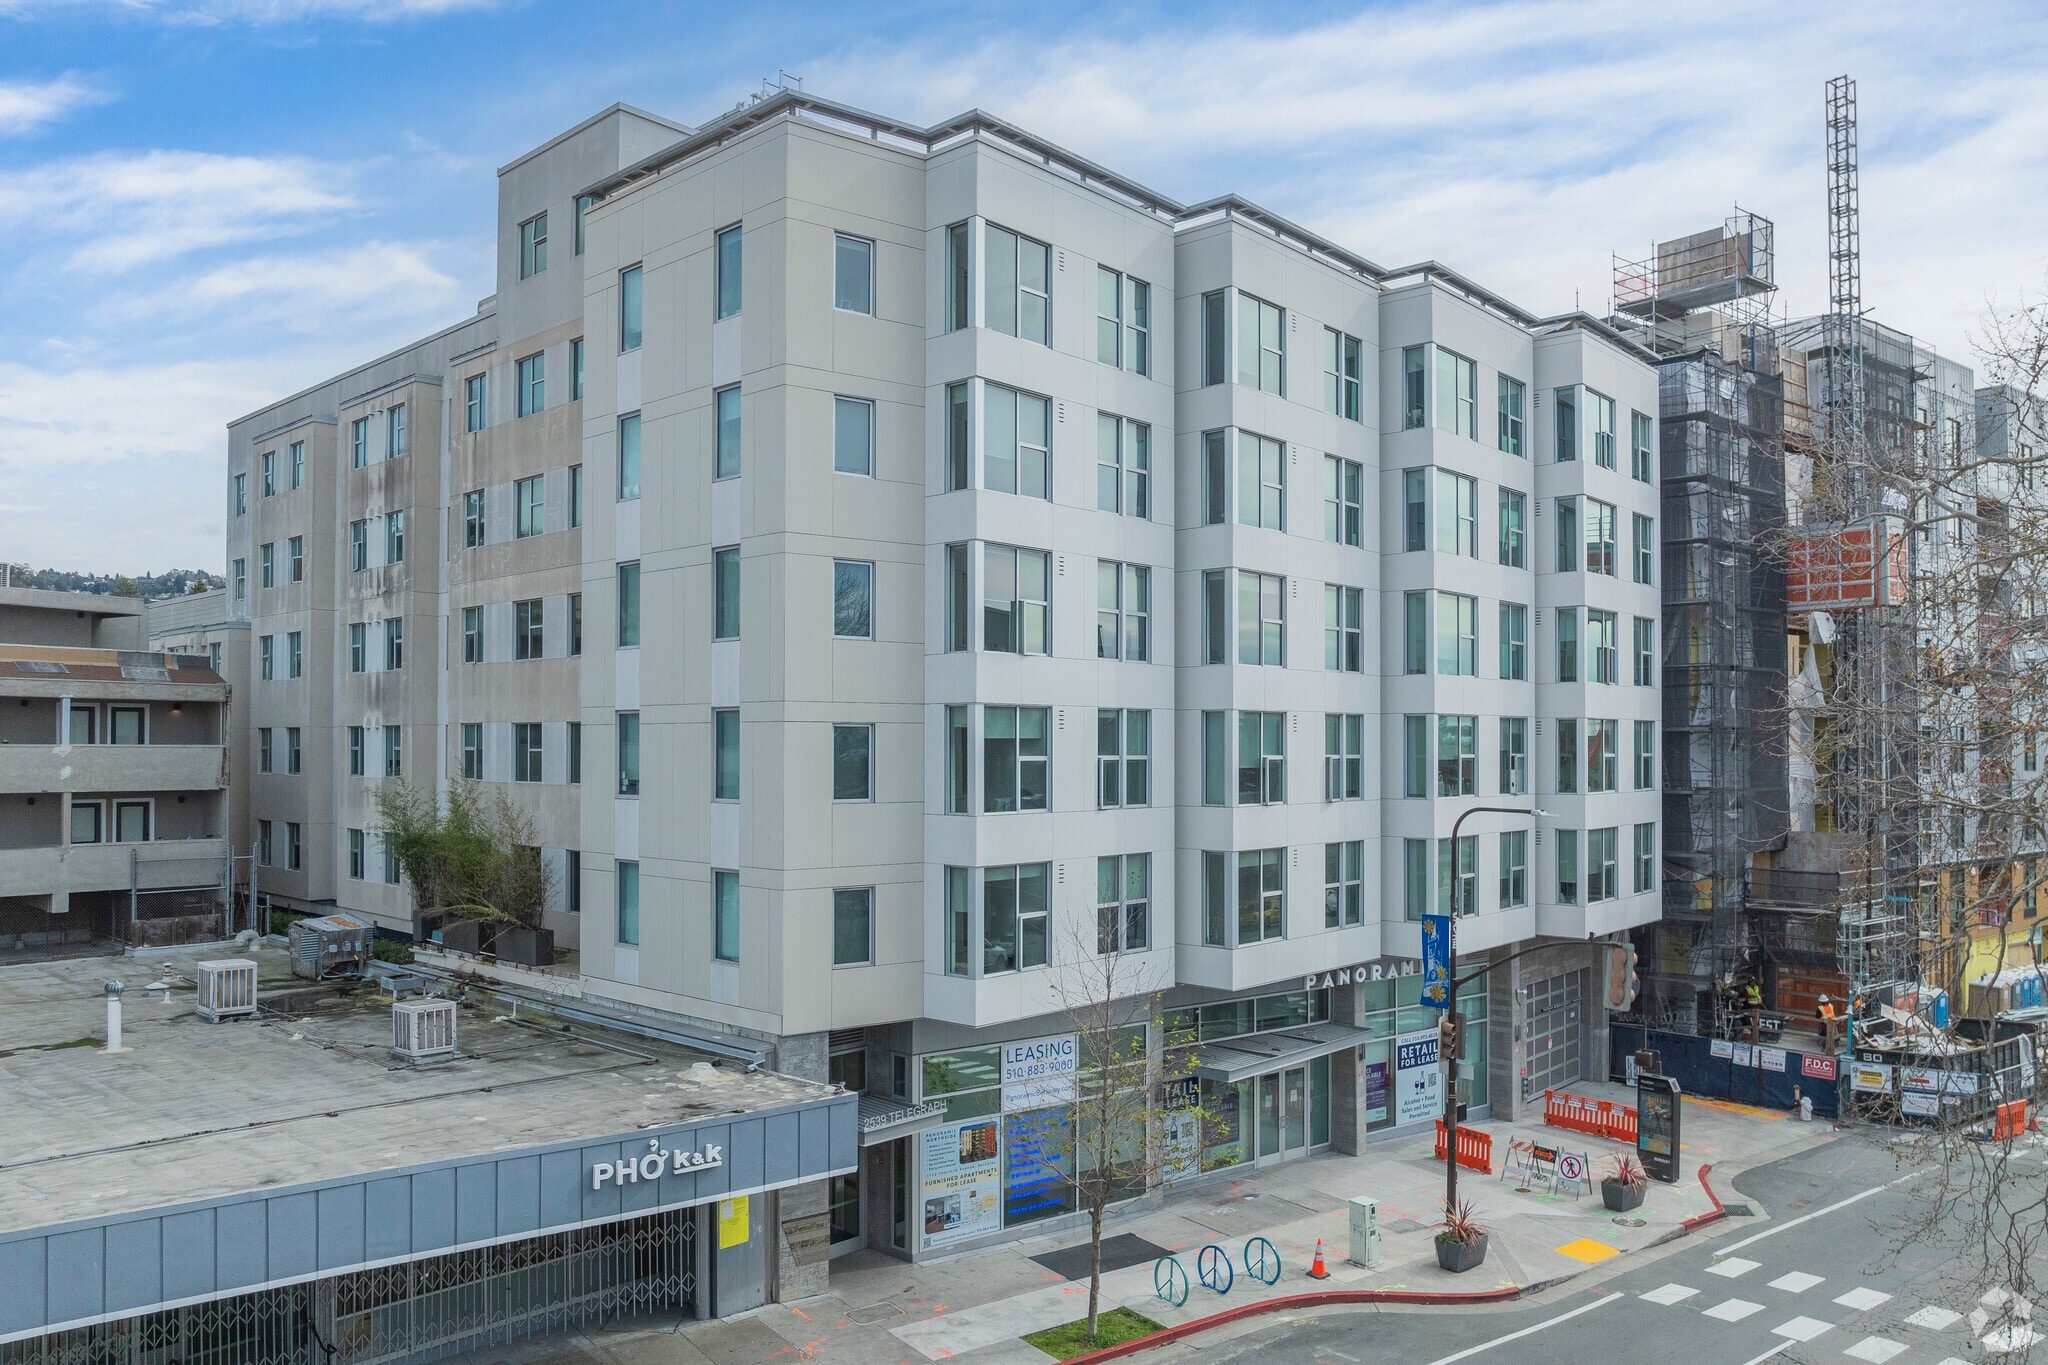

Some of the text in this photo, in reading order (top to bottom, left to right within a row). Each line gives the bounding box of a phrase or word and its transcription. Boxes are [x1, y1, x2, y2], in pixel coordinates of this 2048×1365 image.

[1306, 960, 1424, 990] PANORAM
[1006, 1040, 1072, 1064] LEASING
[1401, 1041, 1438, 1059] RETAIL
[1400, 1054, 1438, 1068] FOR LEASE
[1805, 1058, 1833, 1071] F.D.C.
[1164, 1081, 1196, 1097] TAIL
[1404, 1097, 1420, 1106] Alcohol
[864, 1099, 947, 1129] 2539 TELEGRAPH
[925, 1128, 957, 1138] PANORAMIC
[926, 1134, 957, 1143] NORTHSIDE
[925, 1167, 997, 1186] FURNISHED APARTMENTS
[960, 1178, 977, 1186] LEASE
